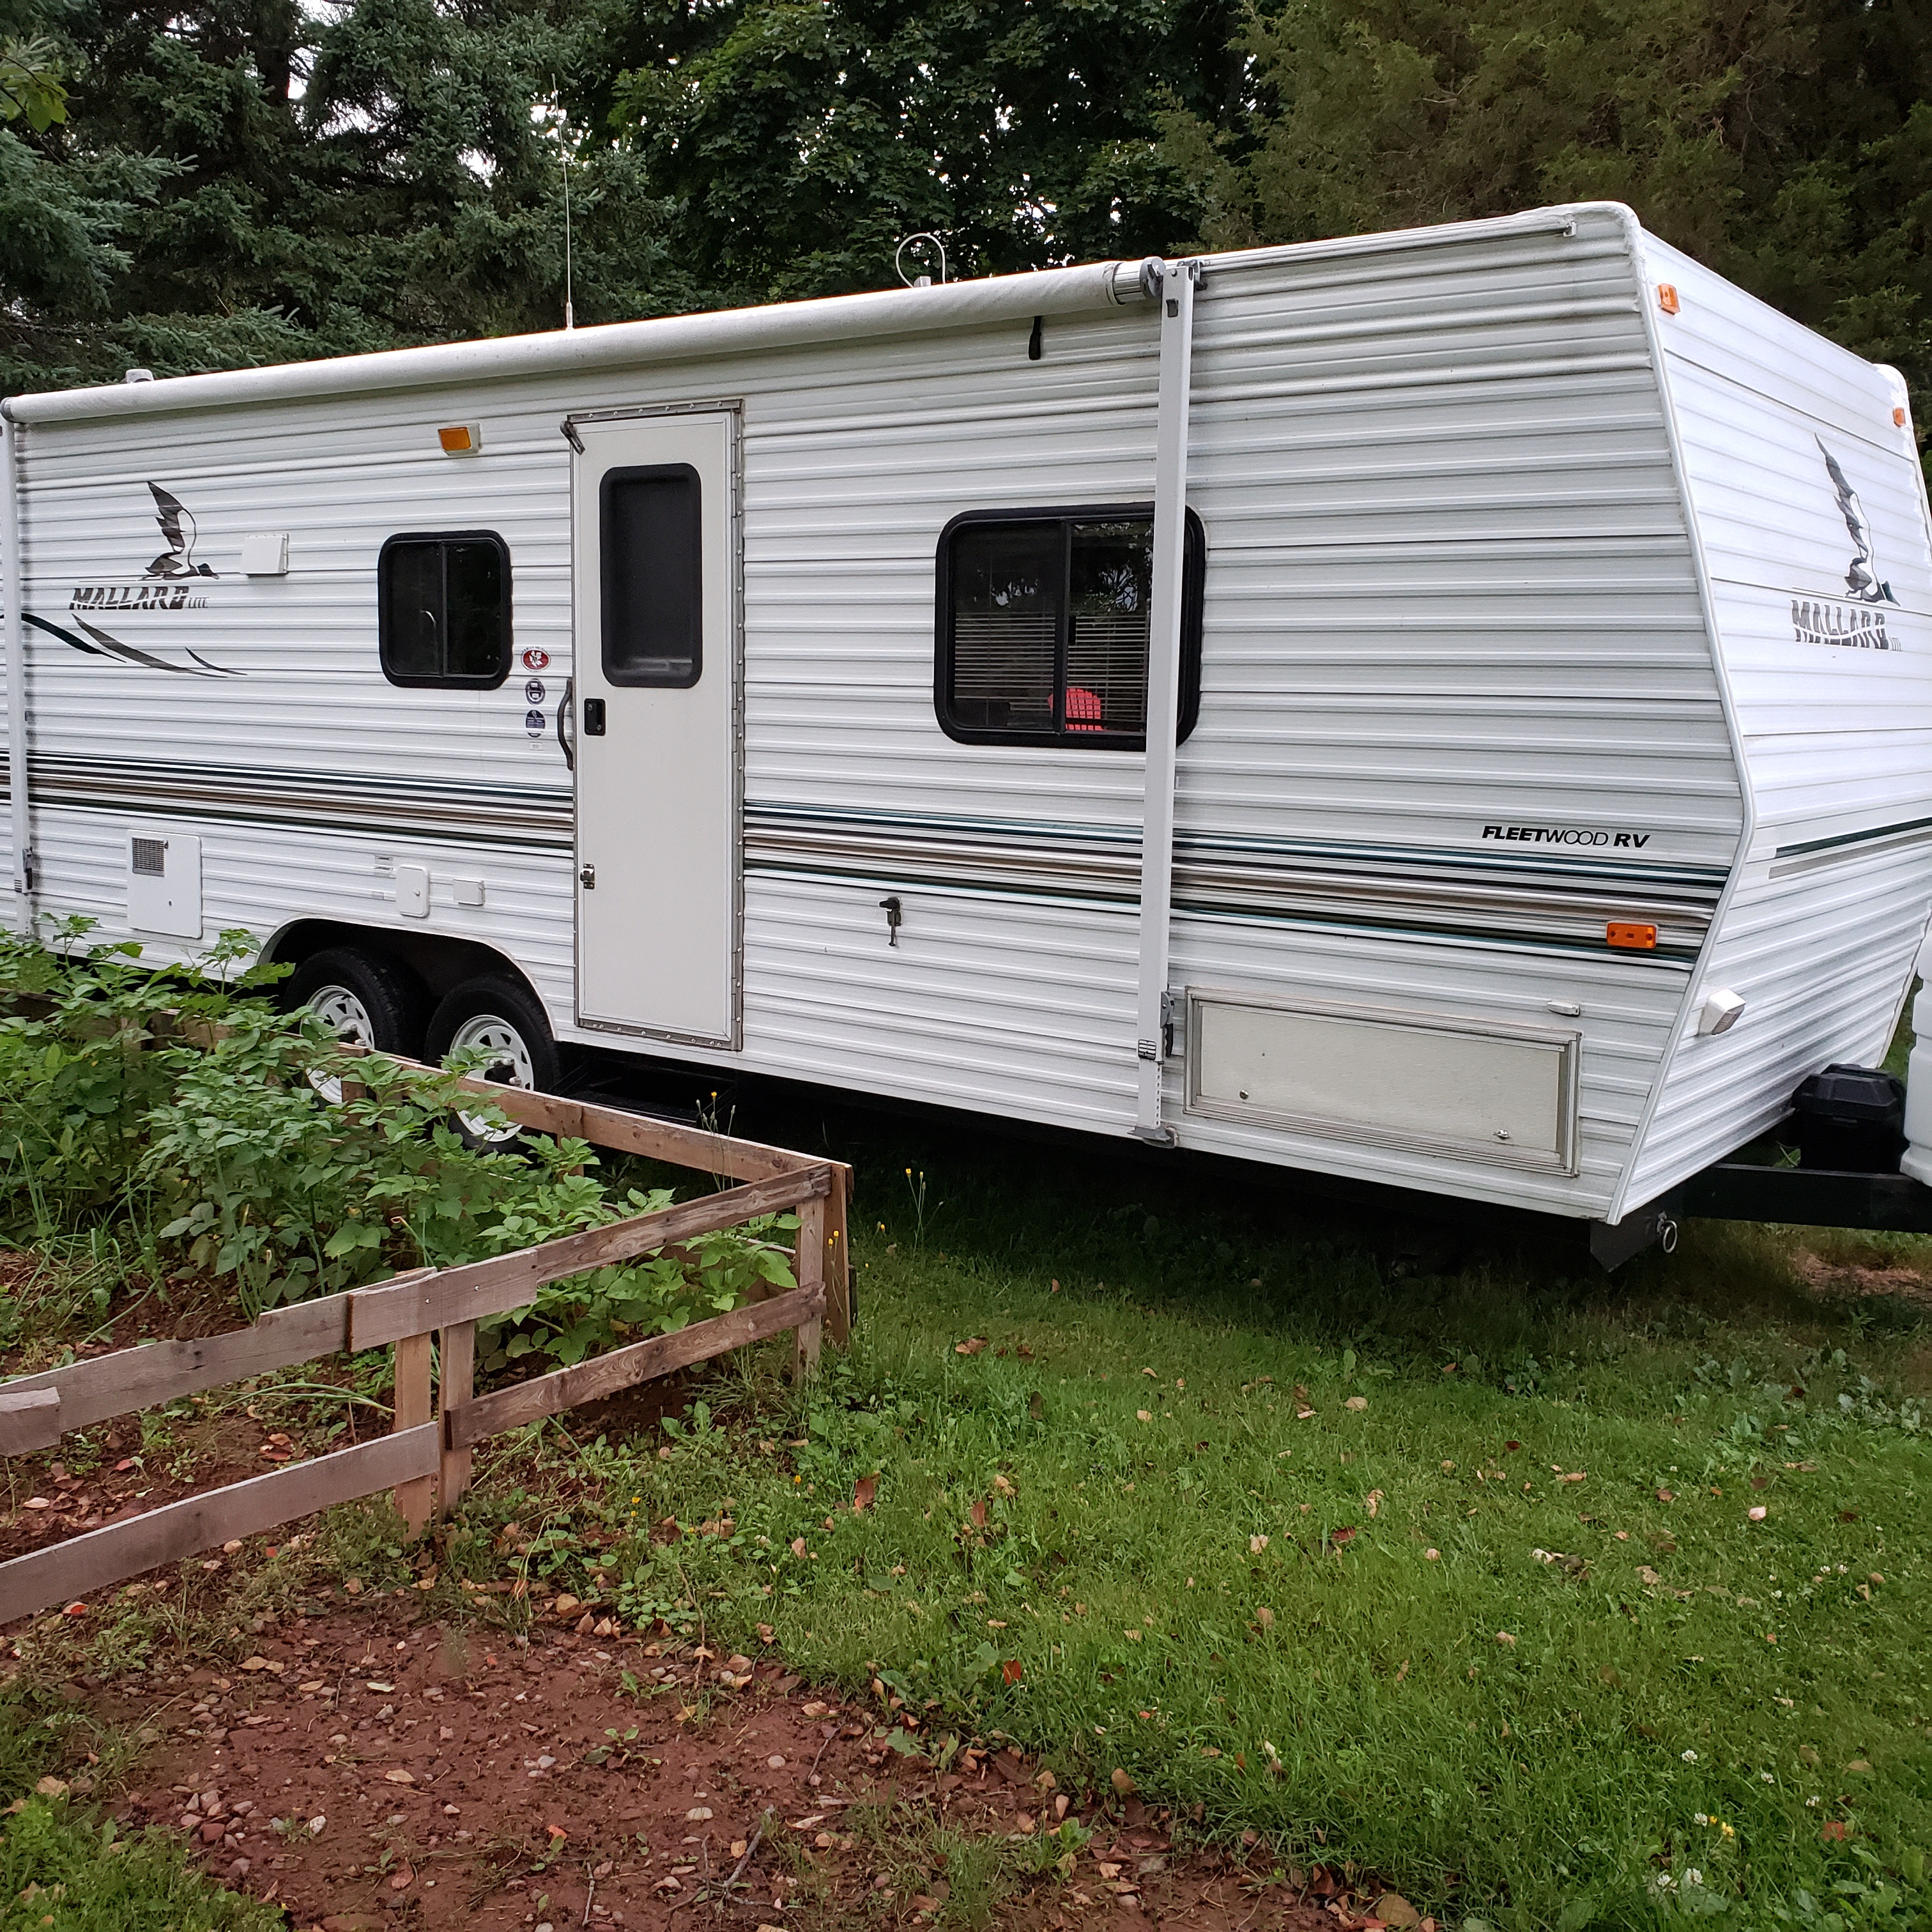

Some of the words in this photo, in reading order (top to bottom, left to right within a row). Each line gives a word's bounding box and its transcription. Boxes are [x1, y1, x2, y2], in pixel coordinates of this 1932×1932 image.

[69, 586, 190, 610] MALLARD
[1791, 599, 1889, 650] MALLARD
[1482, 825, 1609, 846] FLEETWOOD
[1613, 833, 1651, 848] RV
